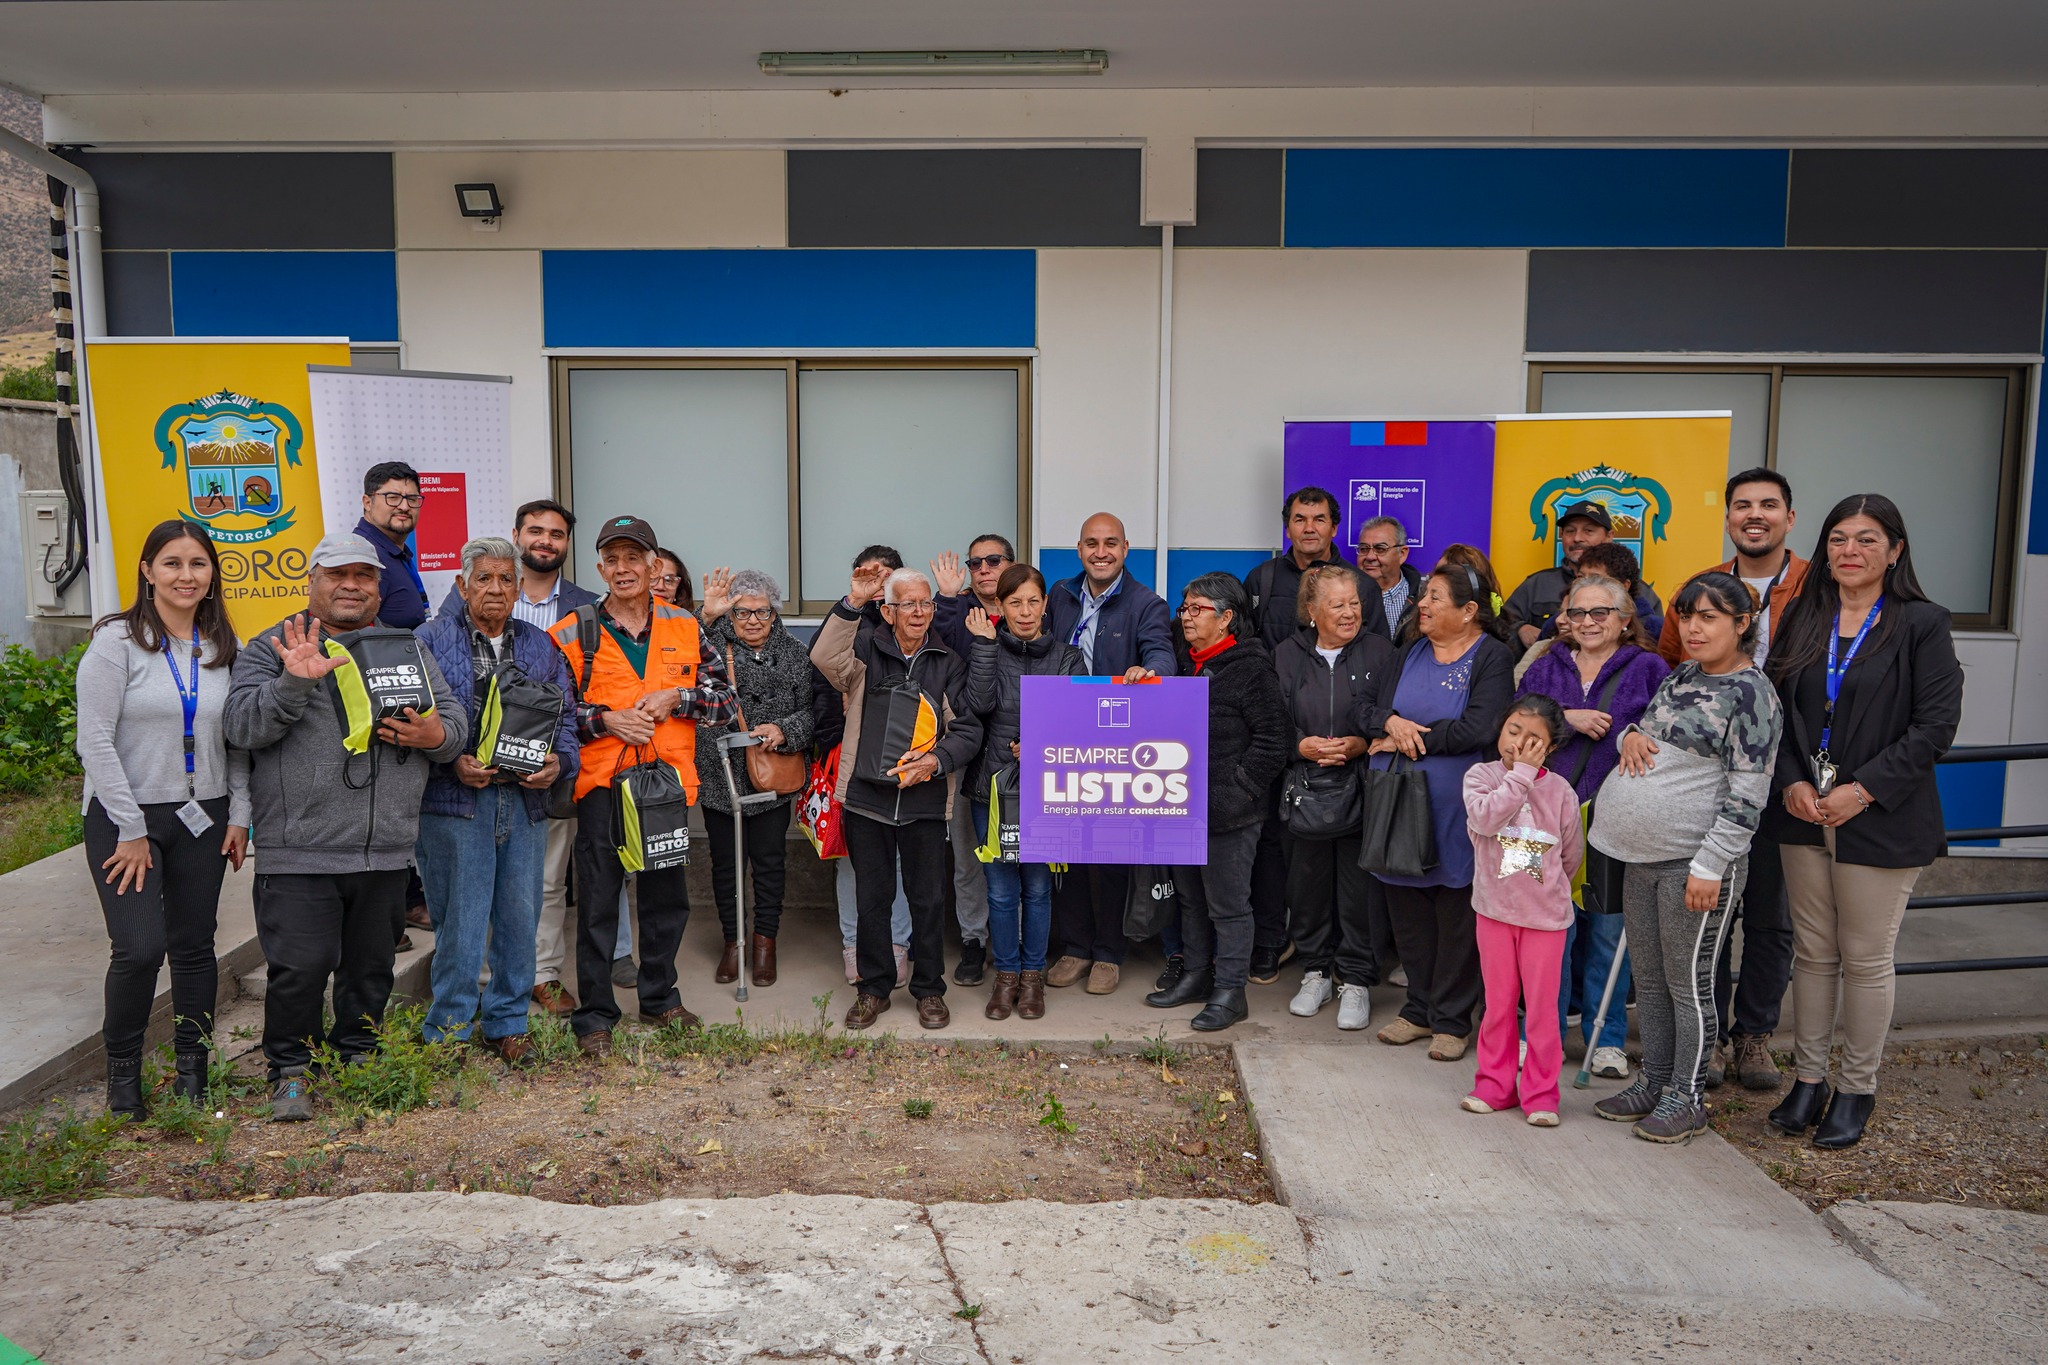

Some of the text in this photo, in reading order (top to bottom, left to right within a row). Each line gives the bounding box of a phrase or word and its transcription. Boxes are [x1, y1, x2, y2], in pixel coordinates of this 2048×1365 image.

[207, 528, 273, 542] PETORCA
[223, 585, 310, 599] CIPALIDAD
[366, 667, 397, 677] SIEMPRE
[368, 675, 422, 690] LISTOS
[500, 734, 530, 746] SIEMPRE
[496, 741, 546, 763] LISTOS
[1044, 747, 1129, 764] SIEMPRE
[1043, 772, 1189, 804] LISTOS
[1043, 805, 1188, 816] Energía para estar conectados
[647, 832, 673, 842] SIEMPRE
[1000, 831, 1020, 842] LIST
[647, 836, 689, 854] LISTOS
[1699, 926, 1719, 962] LOVE
[1697, 970, 1714, 1007] LOVE
